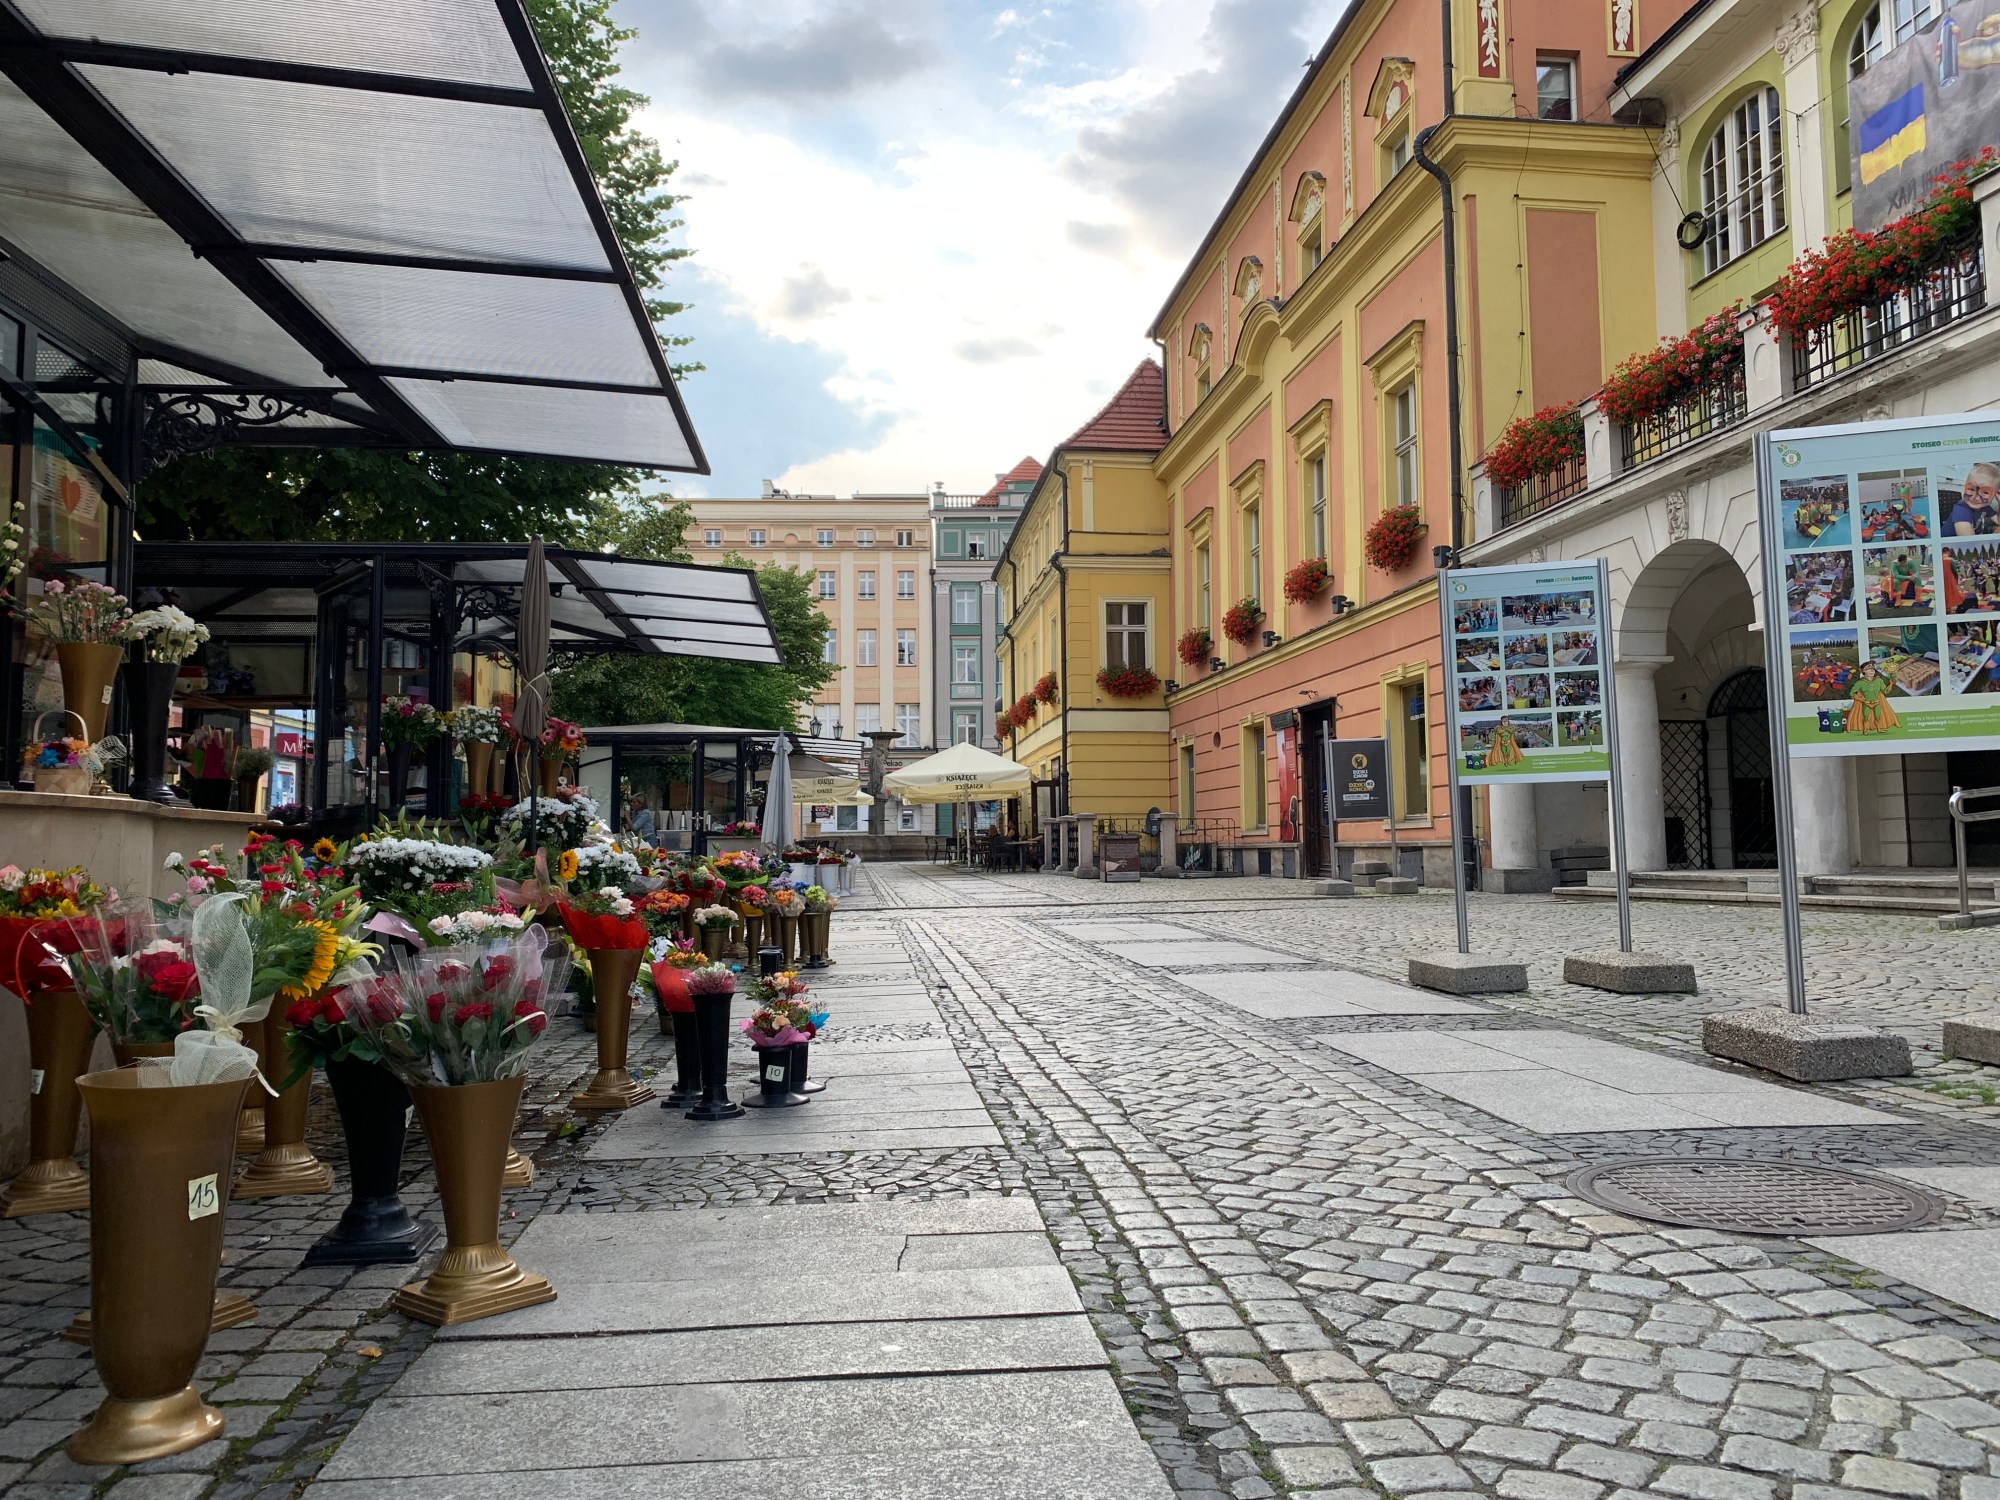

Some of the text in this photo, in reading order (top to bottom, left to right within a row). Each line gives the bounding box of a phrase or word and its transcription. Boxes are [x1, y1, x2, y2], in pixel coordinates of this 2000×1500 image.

[1912, 441, 1941, 449] STOISKO
[1970, 435, 2000, 444] ŚWIDNIC
[770, 1068, 781, 1077] 10
[191, 1180, 215, 1208] 15
